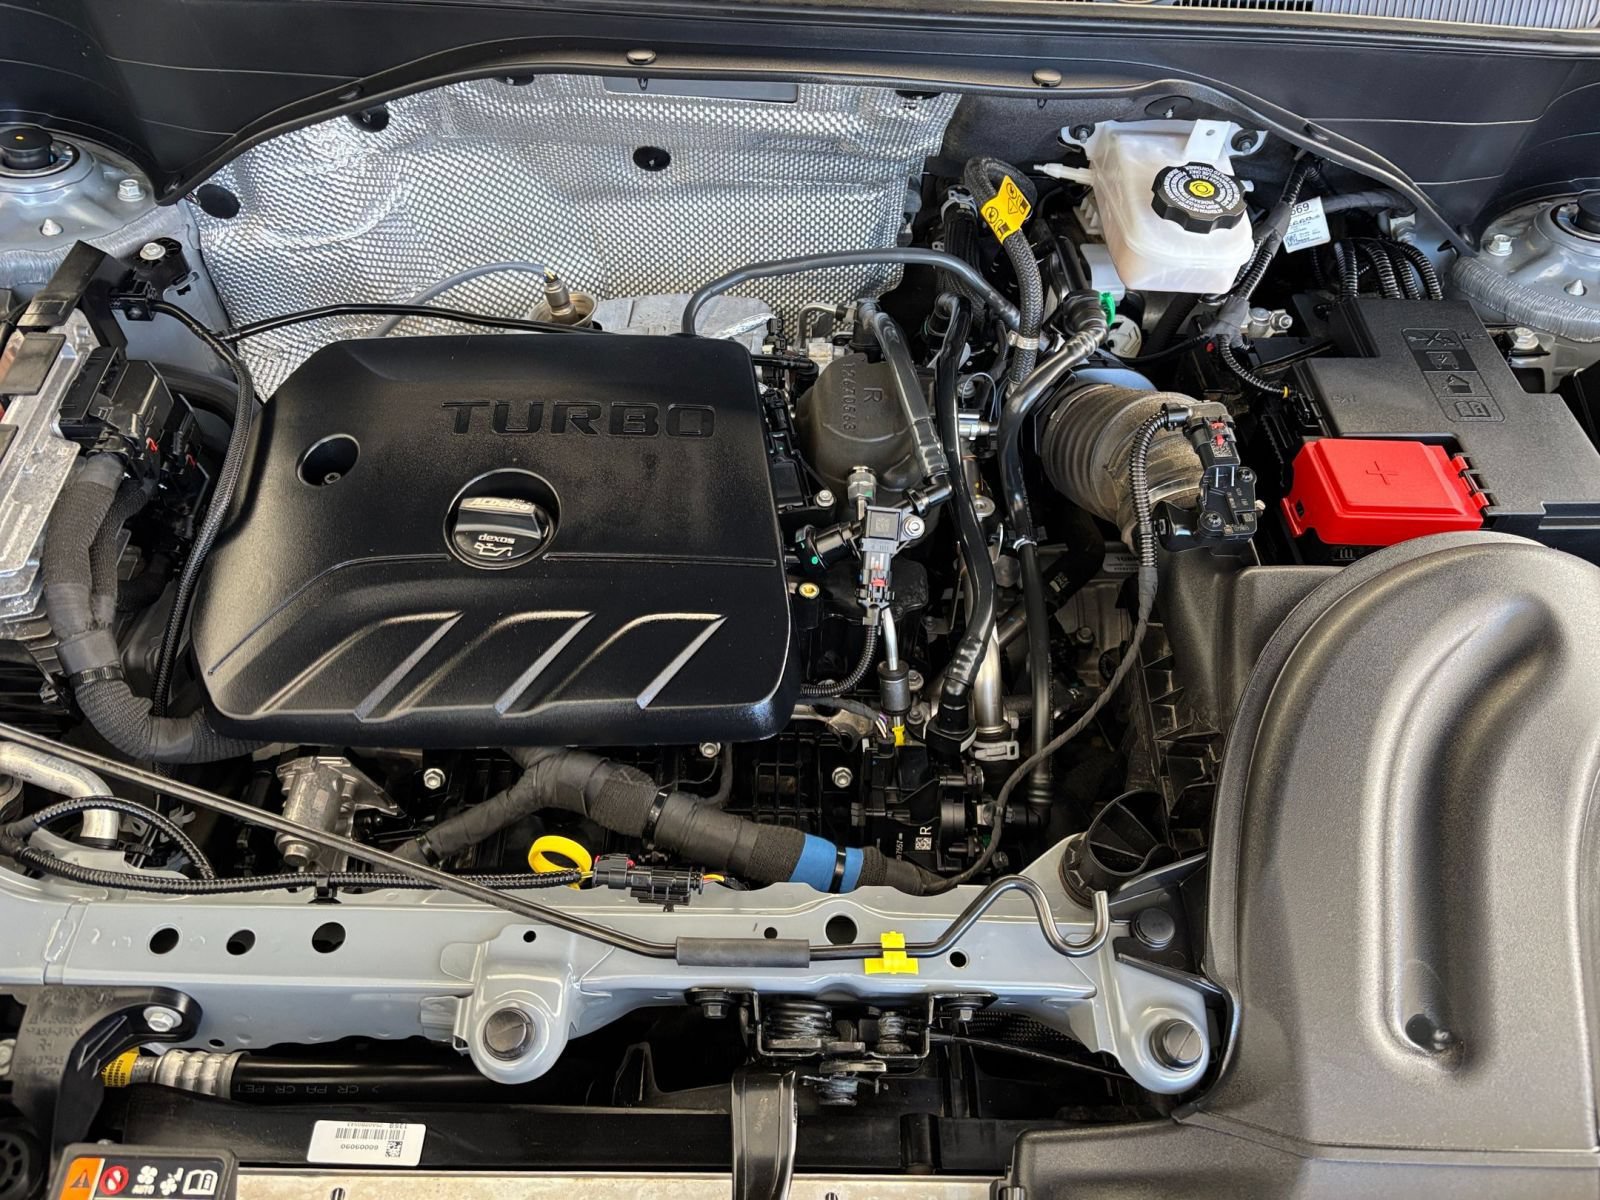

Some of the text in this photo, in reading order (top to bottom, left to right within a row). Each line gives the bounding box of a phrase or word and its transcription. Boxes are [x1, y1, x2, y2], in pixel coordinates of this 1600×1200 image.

[863, 387, 884, 402] R
[441, 400, 716, 438] TURBO
[470, 497, 530, 511] ACDelco
[478, 533, 516, 545] dexos
[919, 826, 932, 835] R
[235, 1084, 360, 1094] CR PA CR PET
[132, 1185, 155, 1195] AUTO
